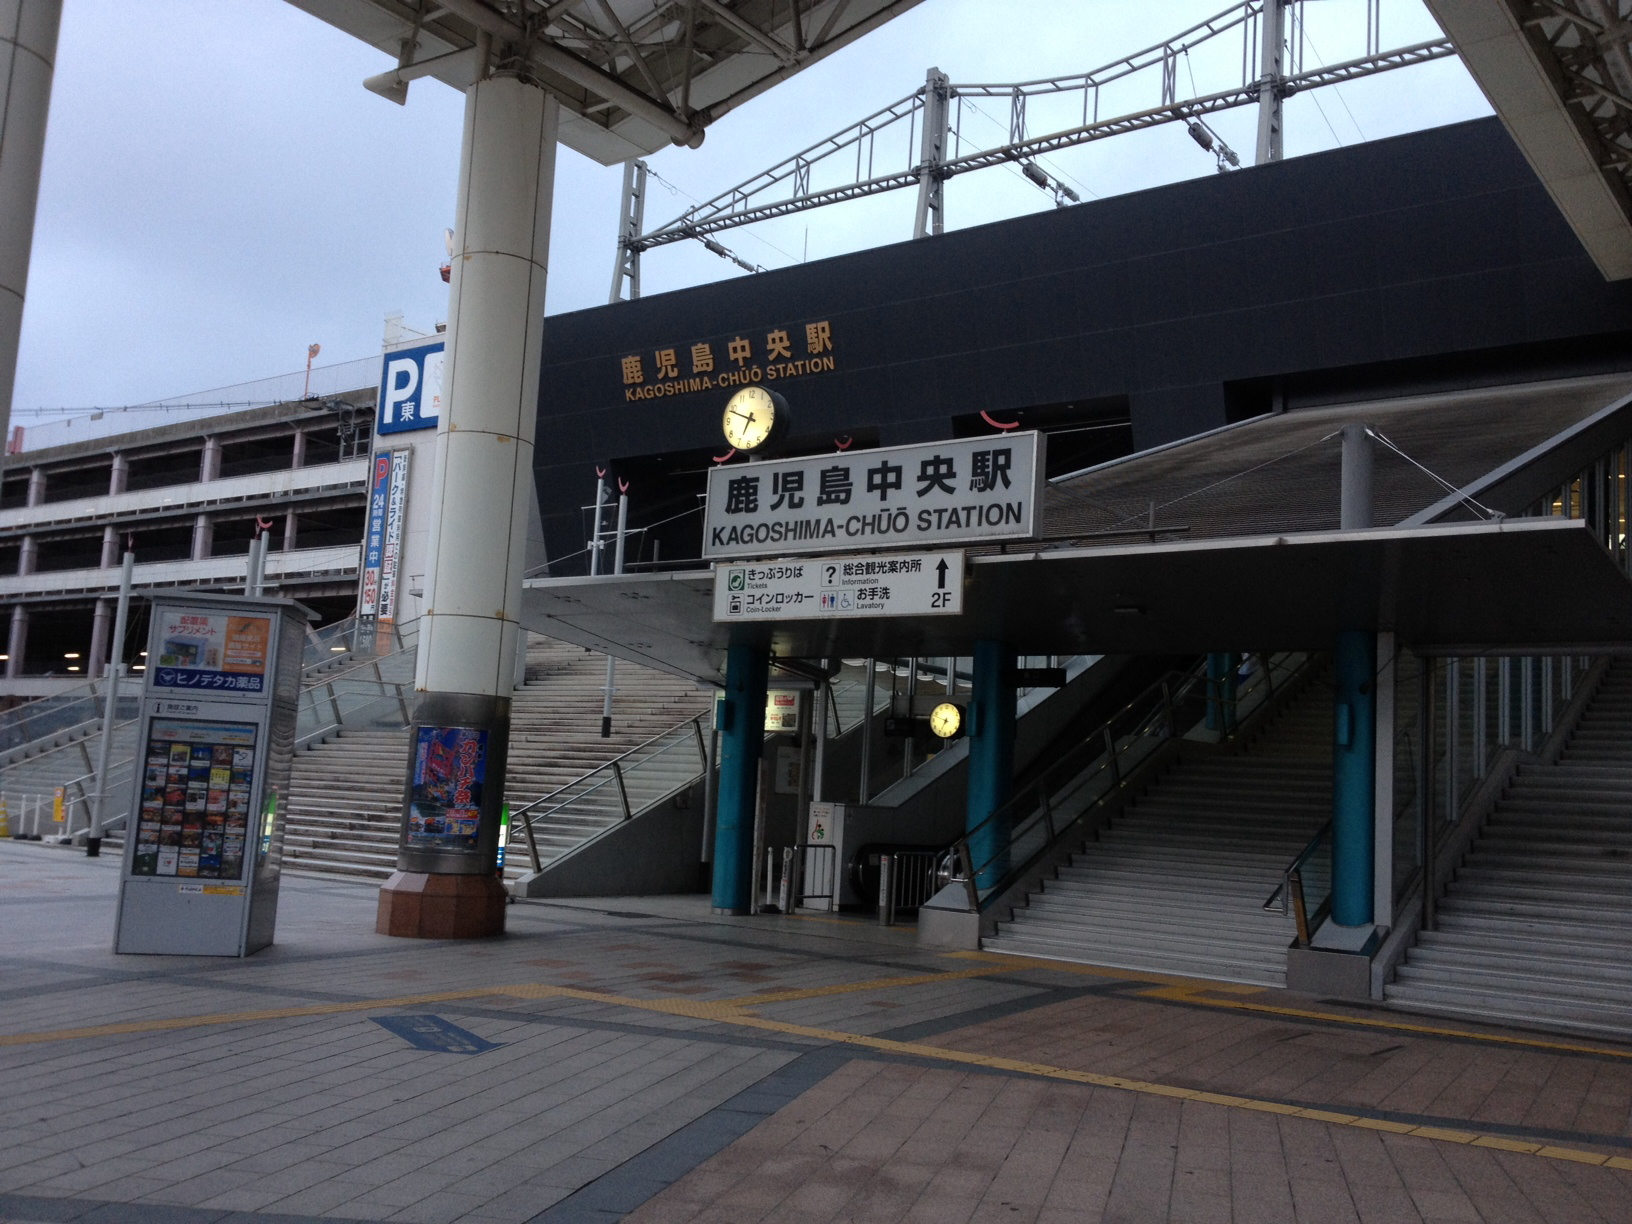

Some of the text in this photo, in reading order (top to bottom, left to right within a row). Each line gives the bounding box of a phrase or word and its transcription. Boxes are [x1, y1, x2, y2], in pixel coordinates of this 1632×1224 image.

[621, 321, 833, 385] 鹿児島中央駅
[767, 356, 835, 381] STATION
[383, 358, 419, 424] P
[400, 401, 416, 422] 東
[374, 457, 389, 489] P
[725, 447, 1013, 515] 鹿児島中央駅
[712, 501, 1024, 547] KAGOSHIMA-CHŪŌ STATION
[747, 565, 804, 581] きっぷうりば
[842, 559, 923, 577] 総合観光案内所
[747, 581, 768, 590] Tickets
[842, 577, 879, 587] Information
[746, 591, 815, 606] コインロッカー
[856, 586, 891, 601] お手洗
[931, 592, 952, 609] 2F
[745, 604, 782, 614] Coin-Locker
[856, 601, 886, 611] Lavatory
[168, 625, 217, 636] サプリメント
[176, 672, 262, 690] ヒノデタカ薬品
